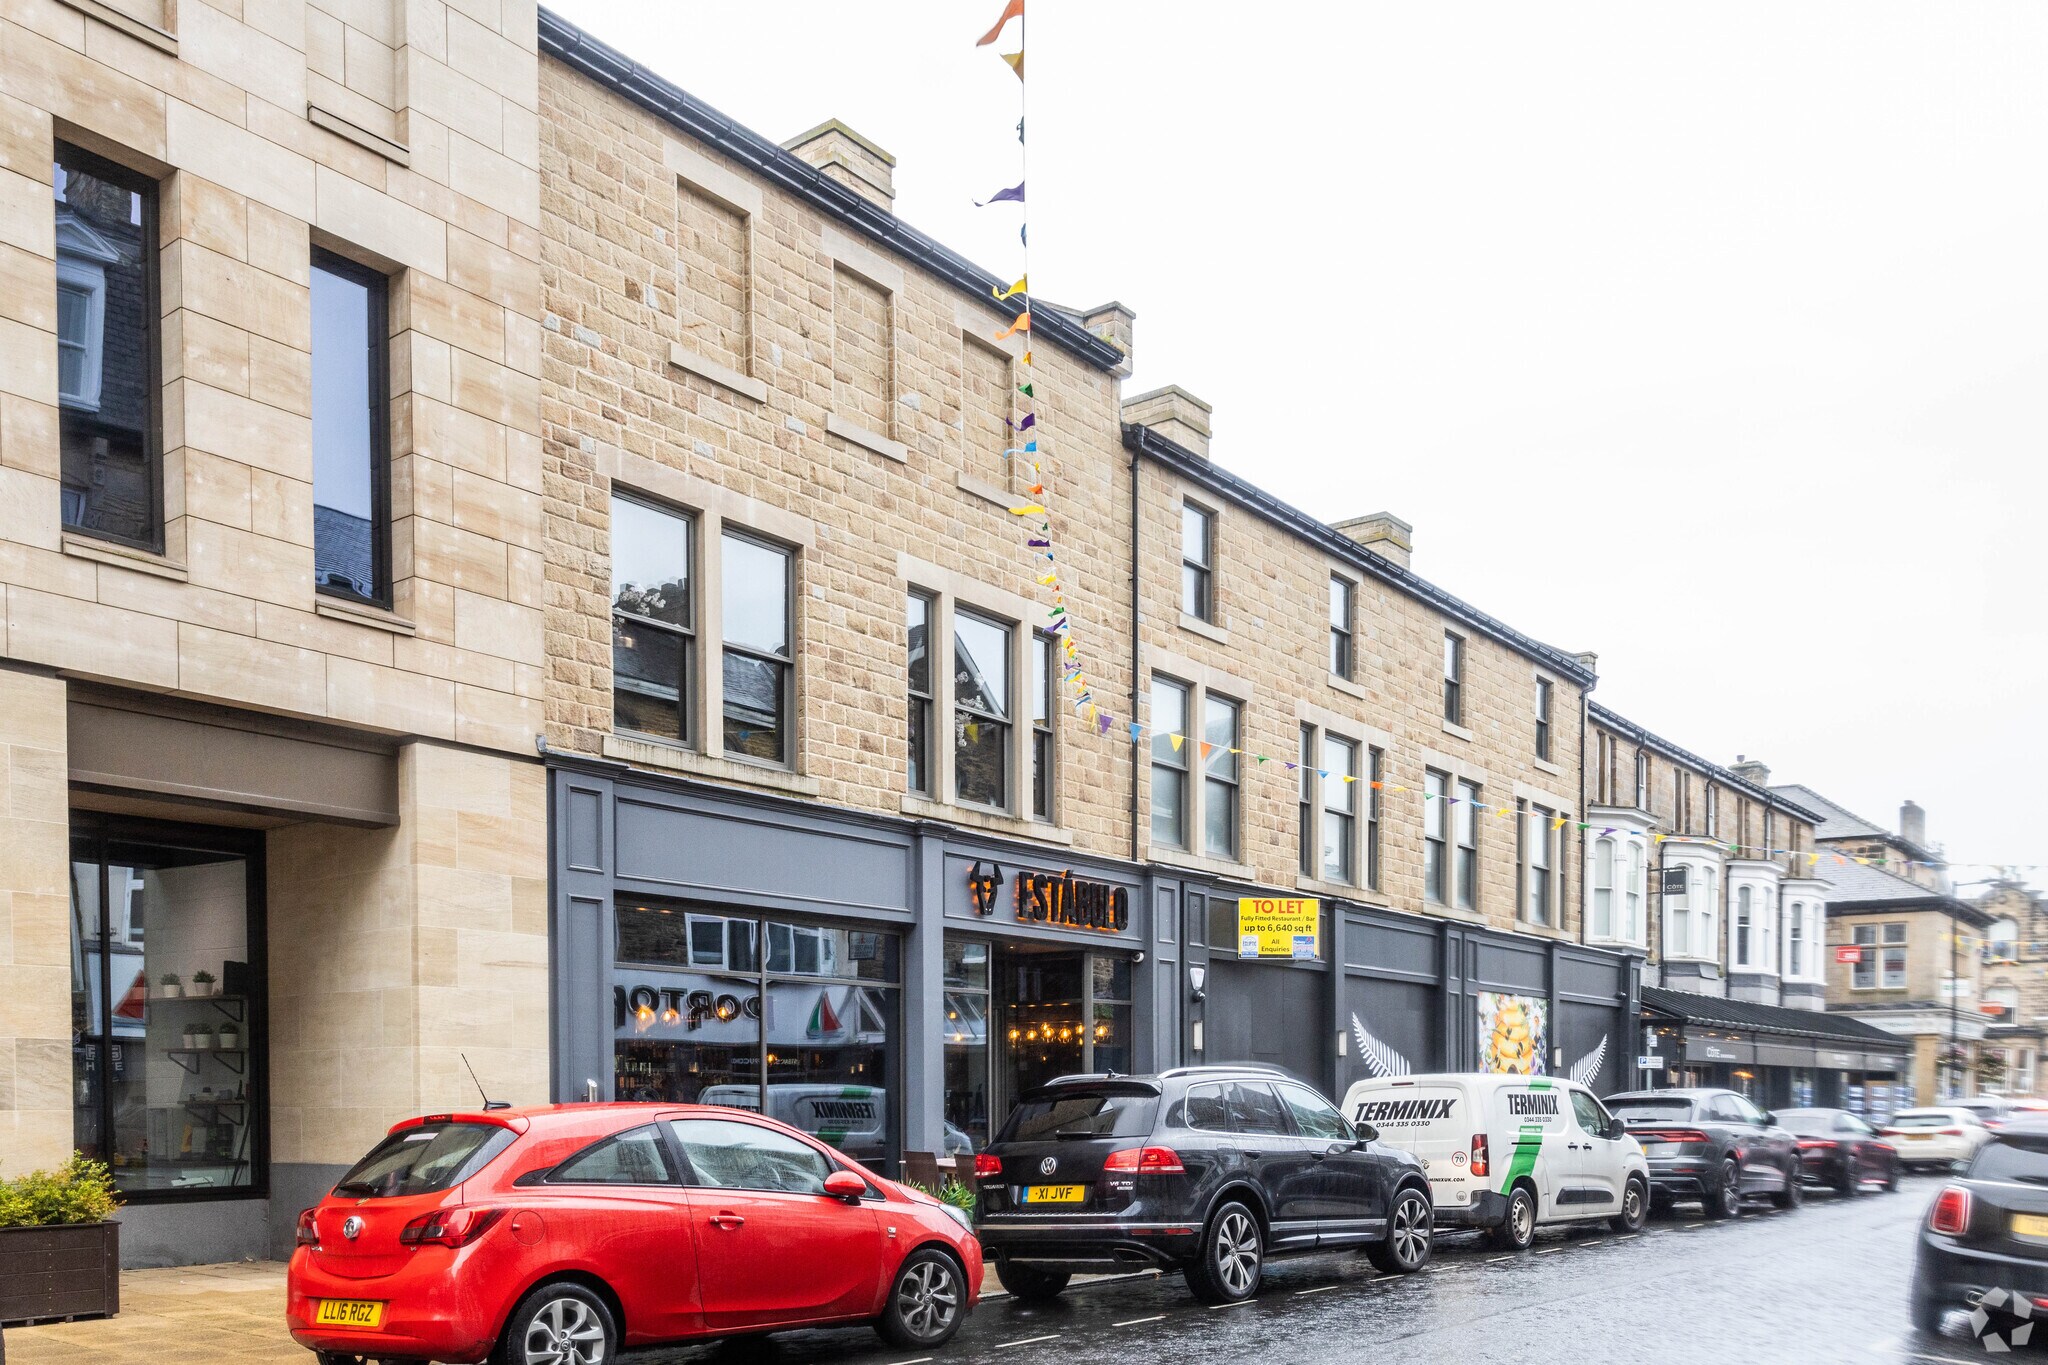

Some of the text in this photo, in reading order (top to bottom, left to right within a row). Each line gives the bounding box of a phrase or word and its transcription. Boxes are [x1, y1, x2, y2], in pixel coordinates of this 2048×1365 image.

[1018, 869, 1129, 931] ESTÁBULO
[1252, 900, 1305, 914] TO LET
[1267, 924, 1293, 933] 6,640
[1354, 1099, 1457, 1122] TERMINIX
[1508, 1094, 1559, 1115] TERMINIX
[1051, 1187, 1073, 1199] JVF
[324, 1303, 374, 1321] LL16 RGZ
